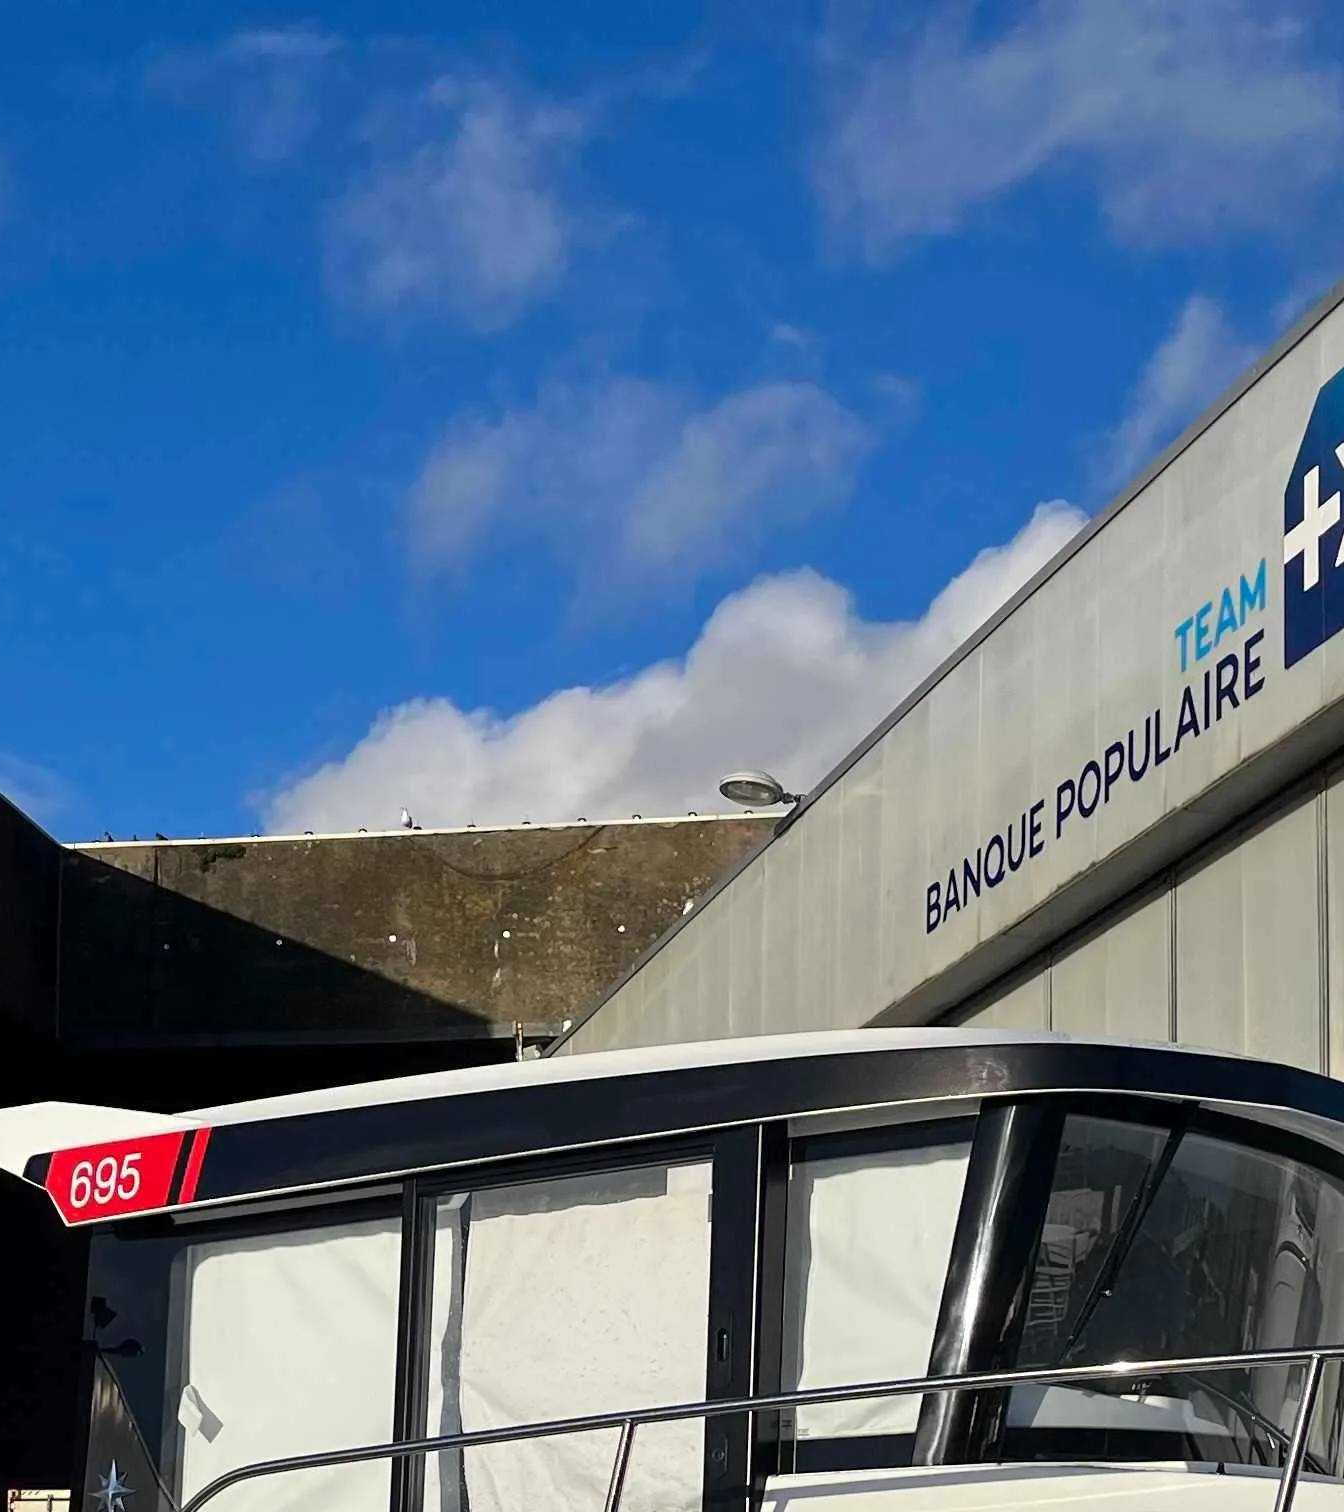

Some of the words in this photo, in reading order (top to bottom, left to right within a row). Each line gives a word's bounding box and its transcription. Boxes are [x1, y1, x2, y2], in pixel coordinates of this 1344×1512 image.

[1174, 556, 1267, 674] TEAM
[925, 800, 1045, 935] BANQUE
[1056, 628, 1265, 840] POPULAIRE
[70, 1152, 143, 1208] 695
